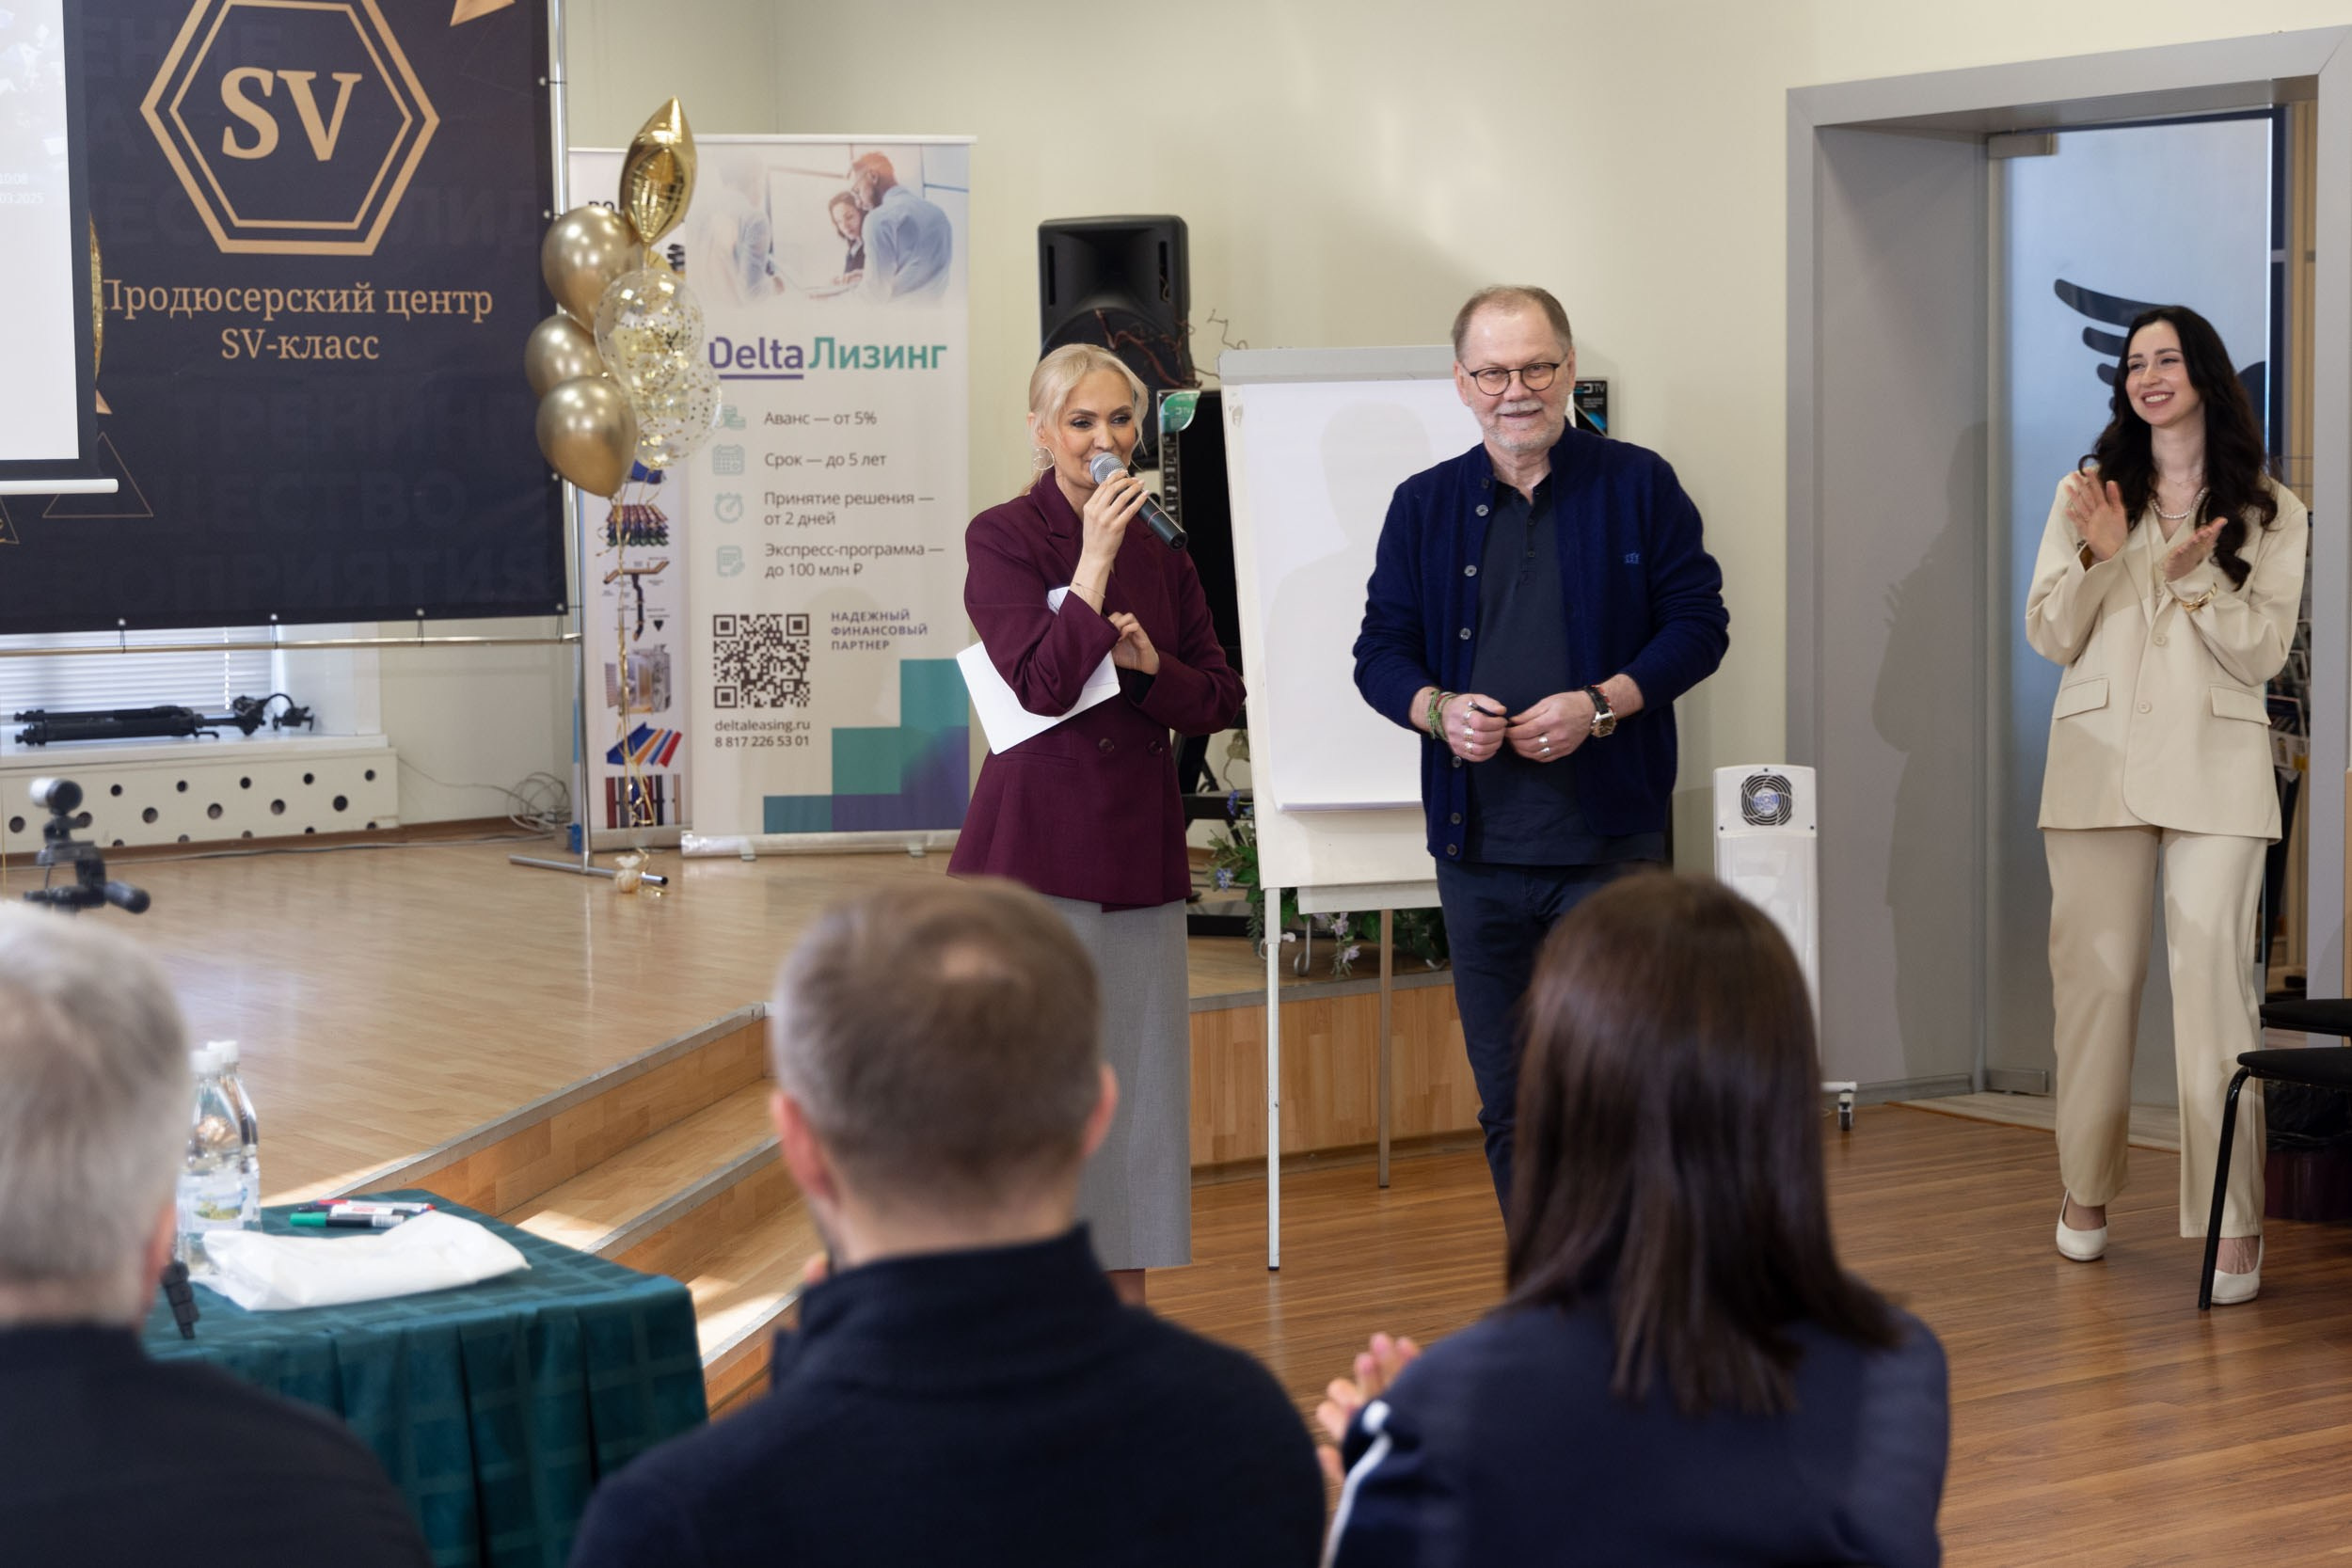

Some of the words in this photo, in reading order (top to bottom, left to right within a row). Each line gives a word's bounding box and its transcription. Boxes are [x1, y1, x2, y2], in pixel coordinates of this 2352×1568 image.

[220, 66, 363, 162] SV
[385, 289, 493, 324] центр
[221, 327, 380, 360] SV-класс
[764, 411, 810, 425] Аванс
[834, 414, 850, 425] от
[854, 411, 877, 425] 5%
[764, 452, 803, 469] Срок
[825, 454, 845, 468] до
[849, 452, 858, 467] 5
[861, 454, 887, 467] лет
[764, 492, 840, 508] Принятие
[845, 494, 914, 508] решения
[764, 515, 780, 525] от
[785, 512, 794, 525] 2
[797, 512, 835, 527] дней
[764, 543, 925, 559] Экспресс-программа
[764, 565, 784, 578] до
[790, 563, 815, 577] 100
[819, 566, 850, 577] млн
[831, 609, 910, 623] НАДЕЖНЫЙ
[831, 625, 928, 636] ФИНАНСОВЫЙ
[832, 640, 890, 651] ПАРТНЕР
[714, 720, 811, 734] deltaleasing.ru
[714, 736, 723, 748] 8
[725, 736, 748, 748] 817
[752, 736, 774, 747] 226
[777, 736, 792, 746] 53
[795, 735, 809, 746] 01
